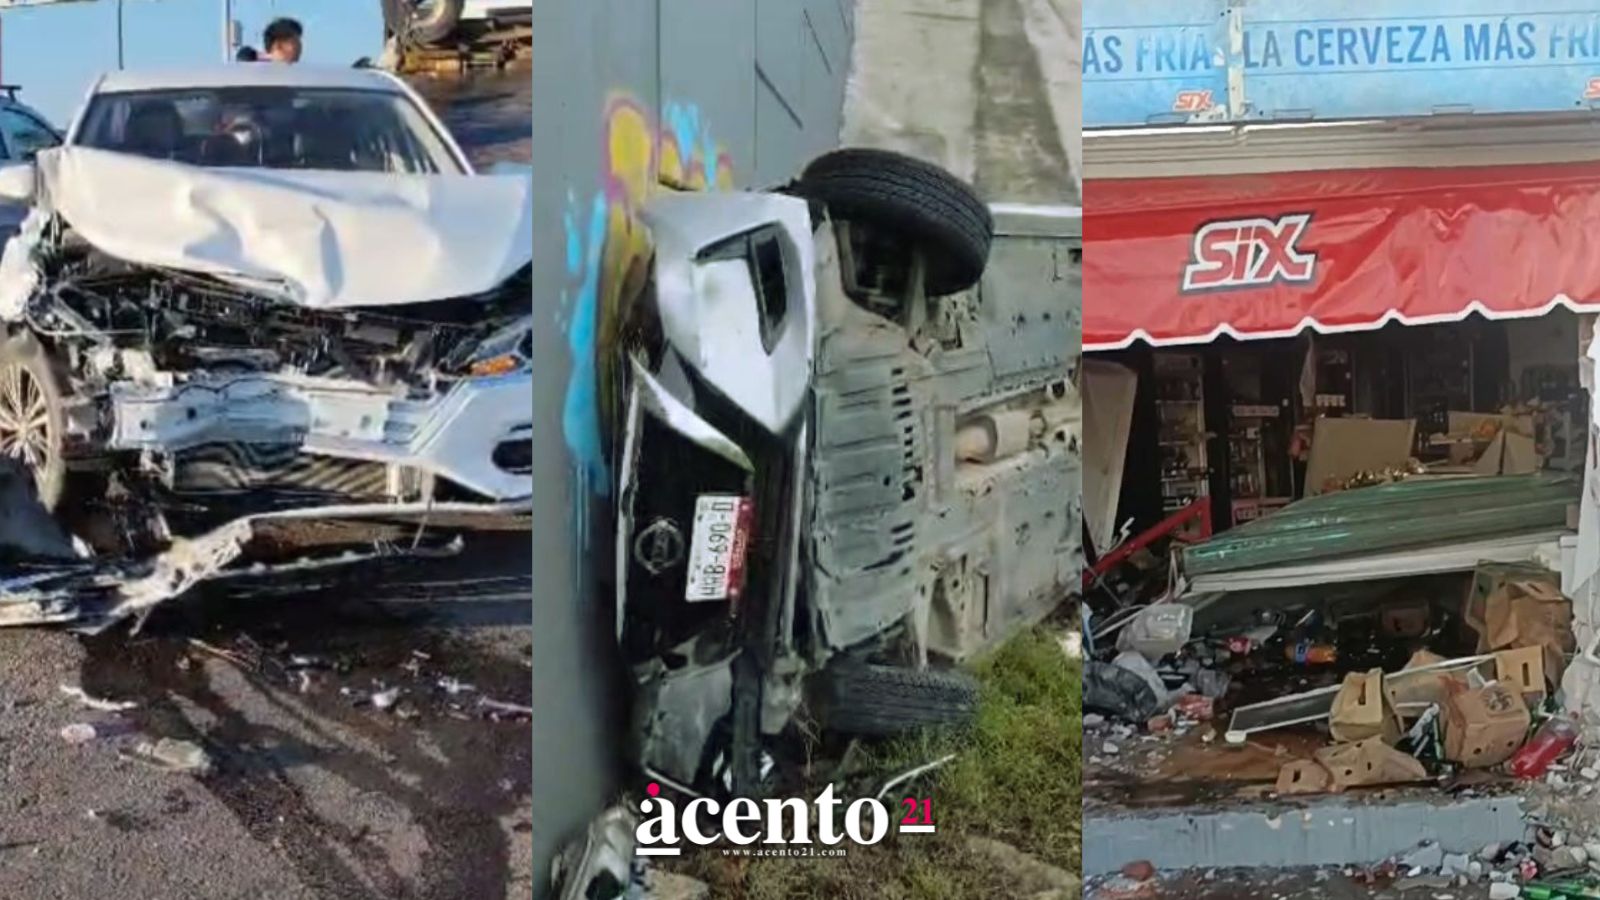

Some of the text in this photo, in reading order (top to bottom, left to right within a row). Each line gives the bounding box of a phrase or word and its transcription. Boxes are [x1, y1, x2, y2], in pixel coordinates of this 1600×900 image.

[1243, 29, 1282, 68] LA
[1294, 24, 1451, 67] CERVEZA
[1464, 15, 1536, 61] MÁS
